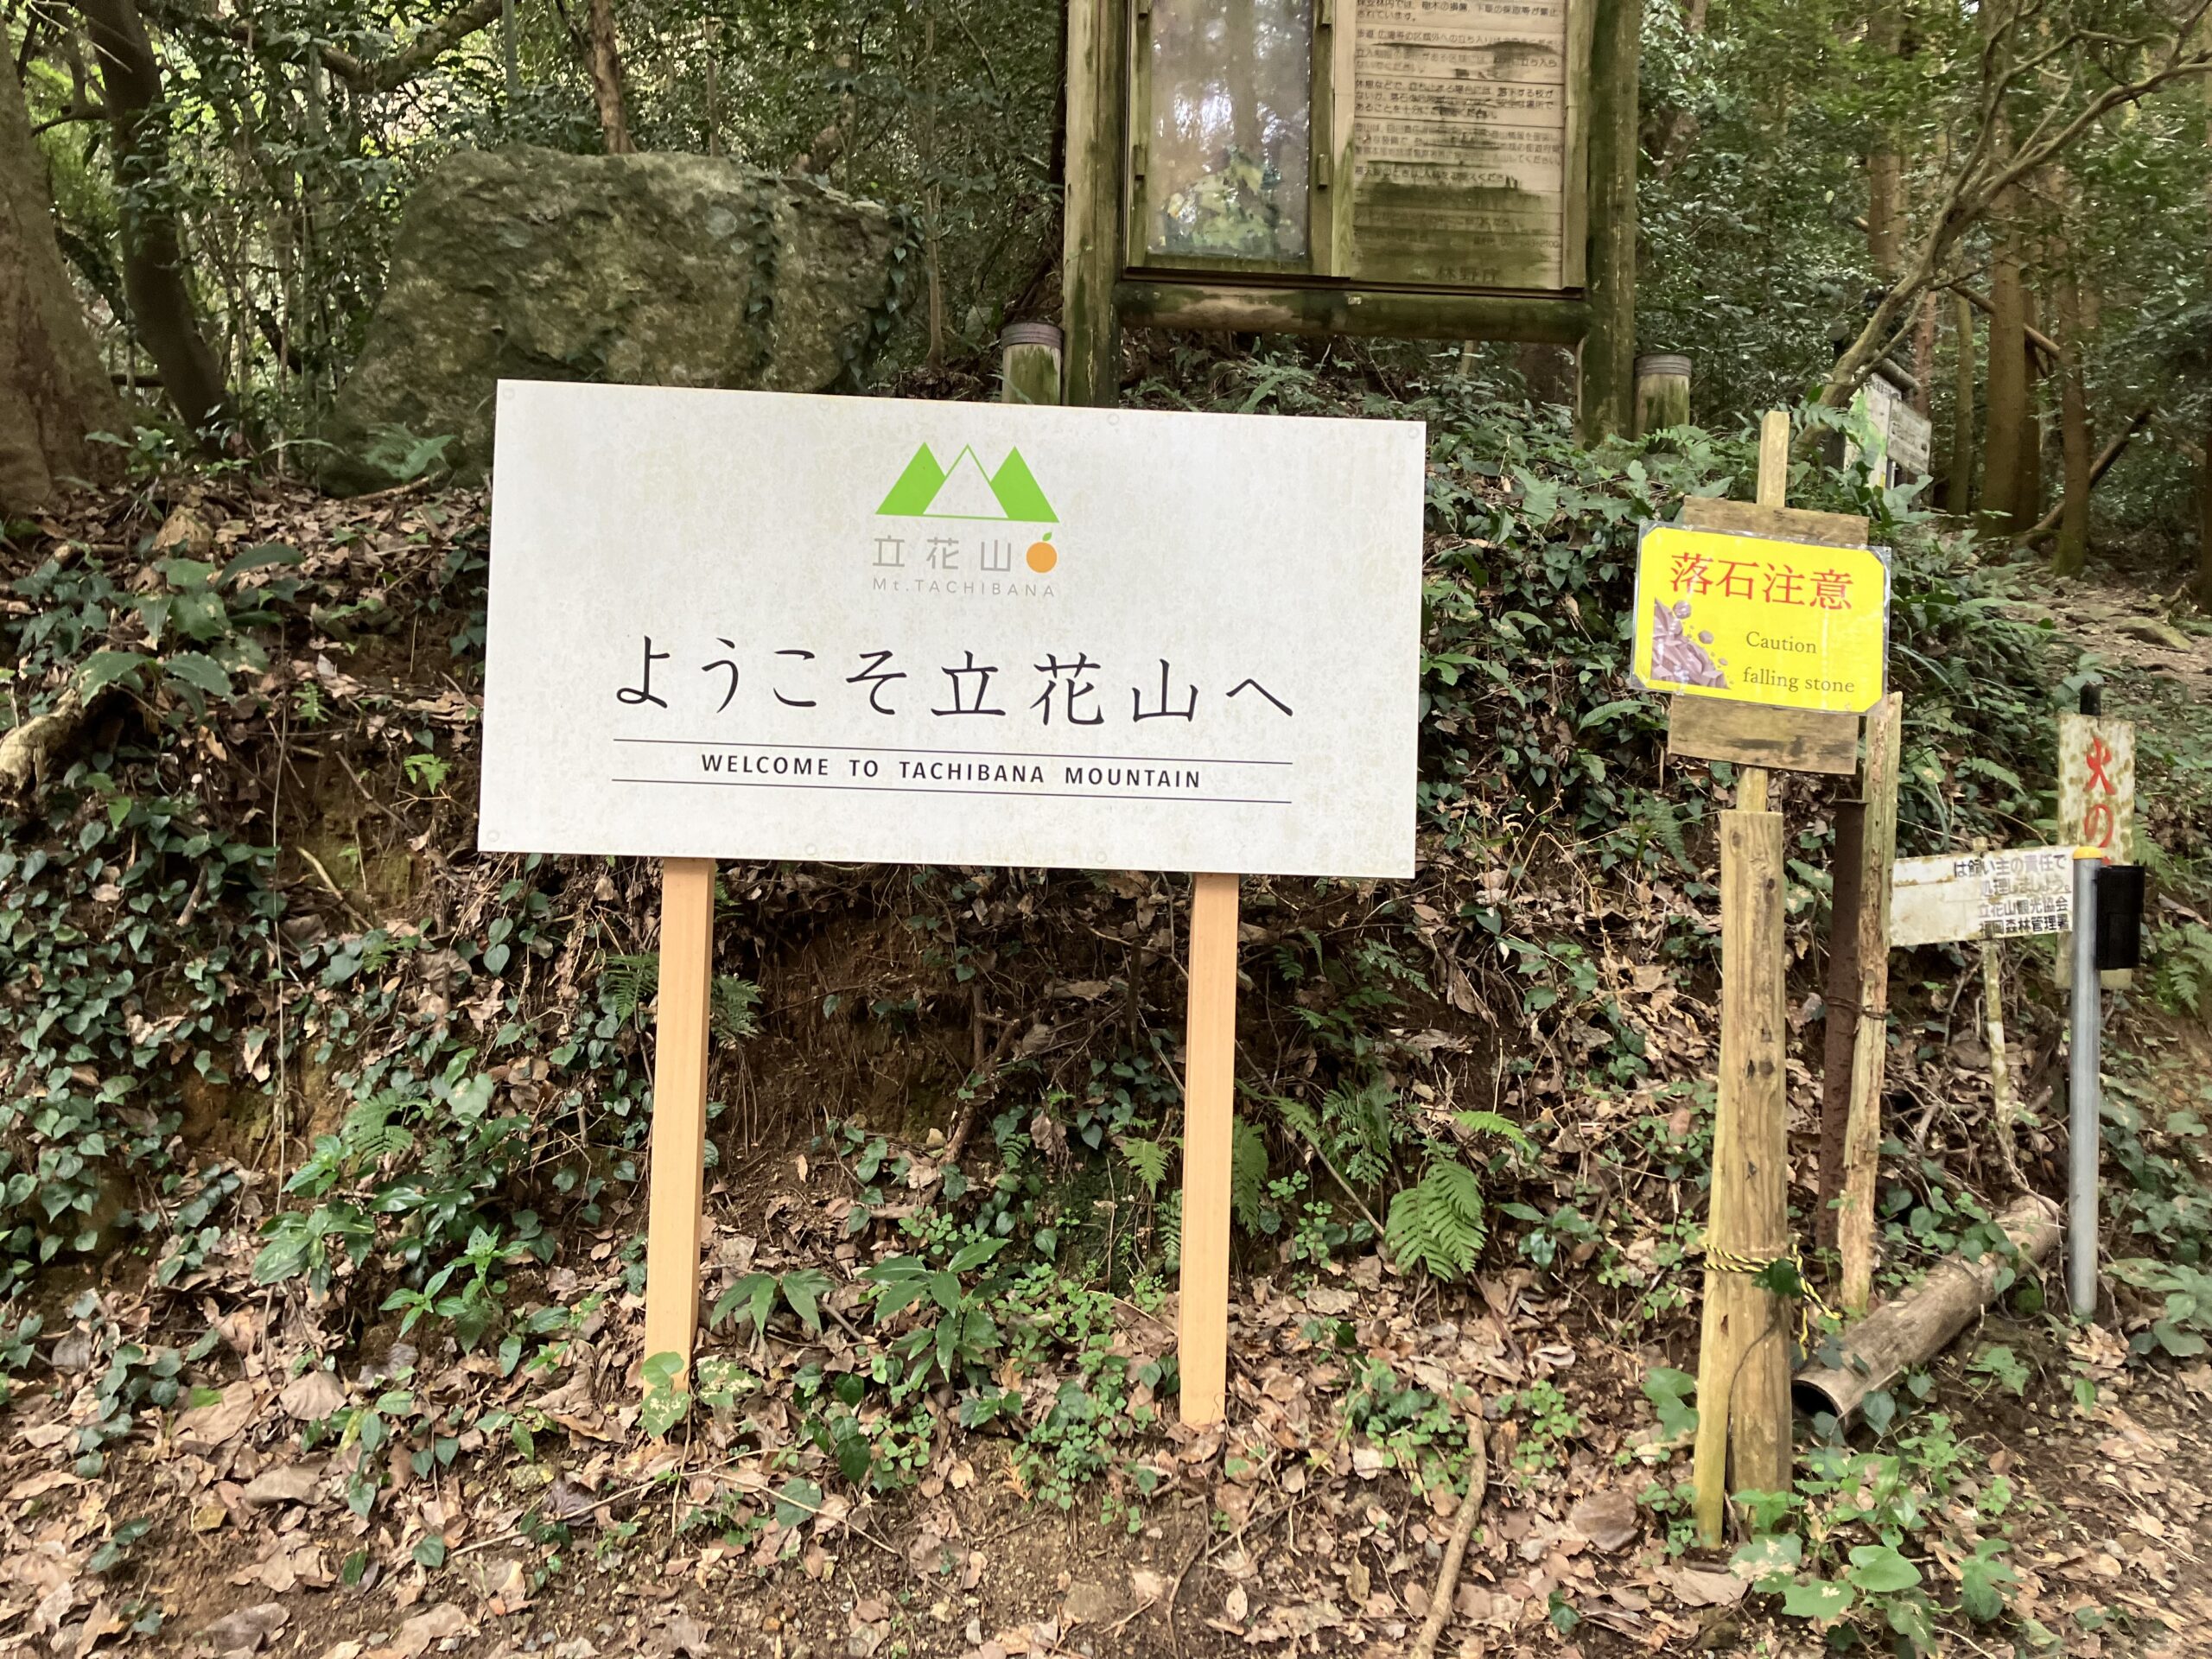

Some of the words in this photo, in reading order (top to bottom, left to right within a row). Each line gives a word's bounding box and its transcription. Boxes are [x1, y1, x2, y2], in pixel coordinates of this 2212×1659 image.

[872, 535, 1012, 572] 立花山
[1670, 552, 1853, 610] 落石注意
[1745, 631, 1817, 654] Caution
[615, 635, 1294, 726] ようこそ立花山へ
[1743, 667, 1800, 693] falling
[1803, 677, 1855, 693] stone
[702, 754, 829, 776] WELCOME
[849, 760, 879, 778] TO
[899, 761, 1045, 784] TACHIBANA
[1065, 767, 1201, 788] MOUNTAIN
[2083, 736, 2116, 865] 火の
